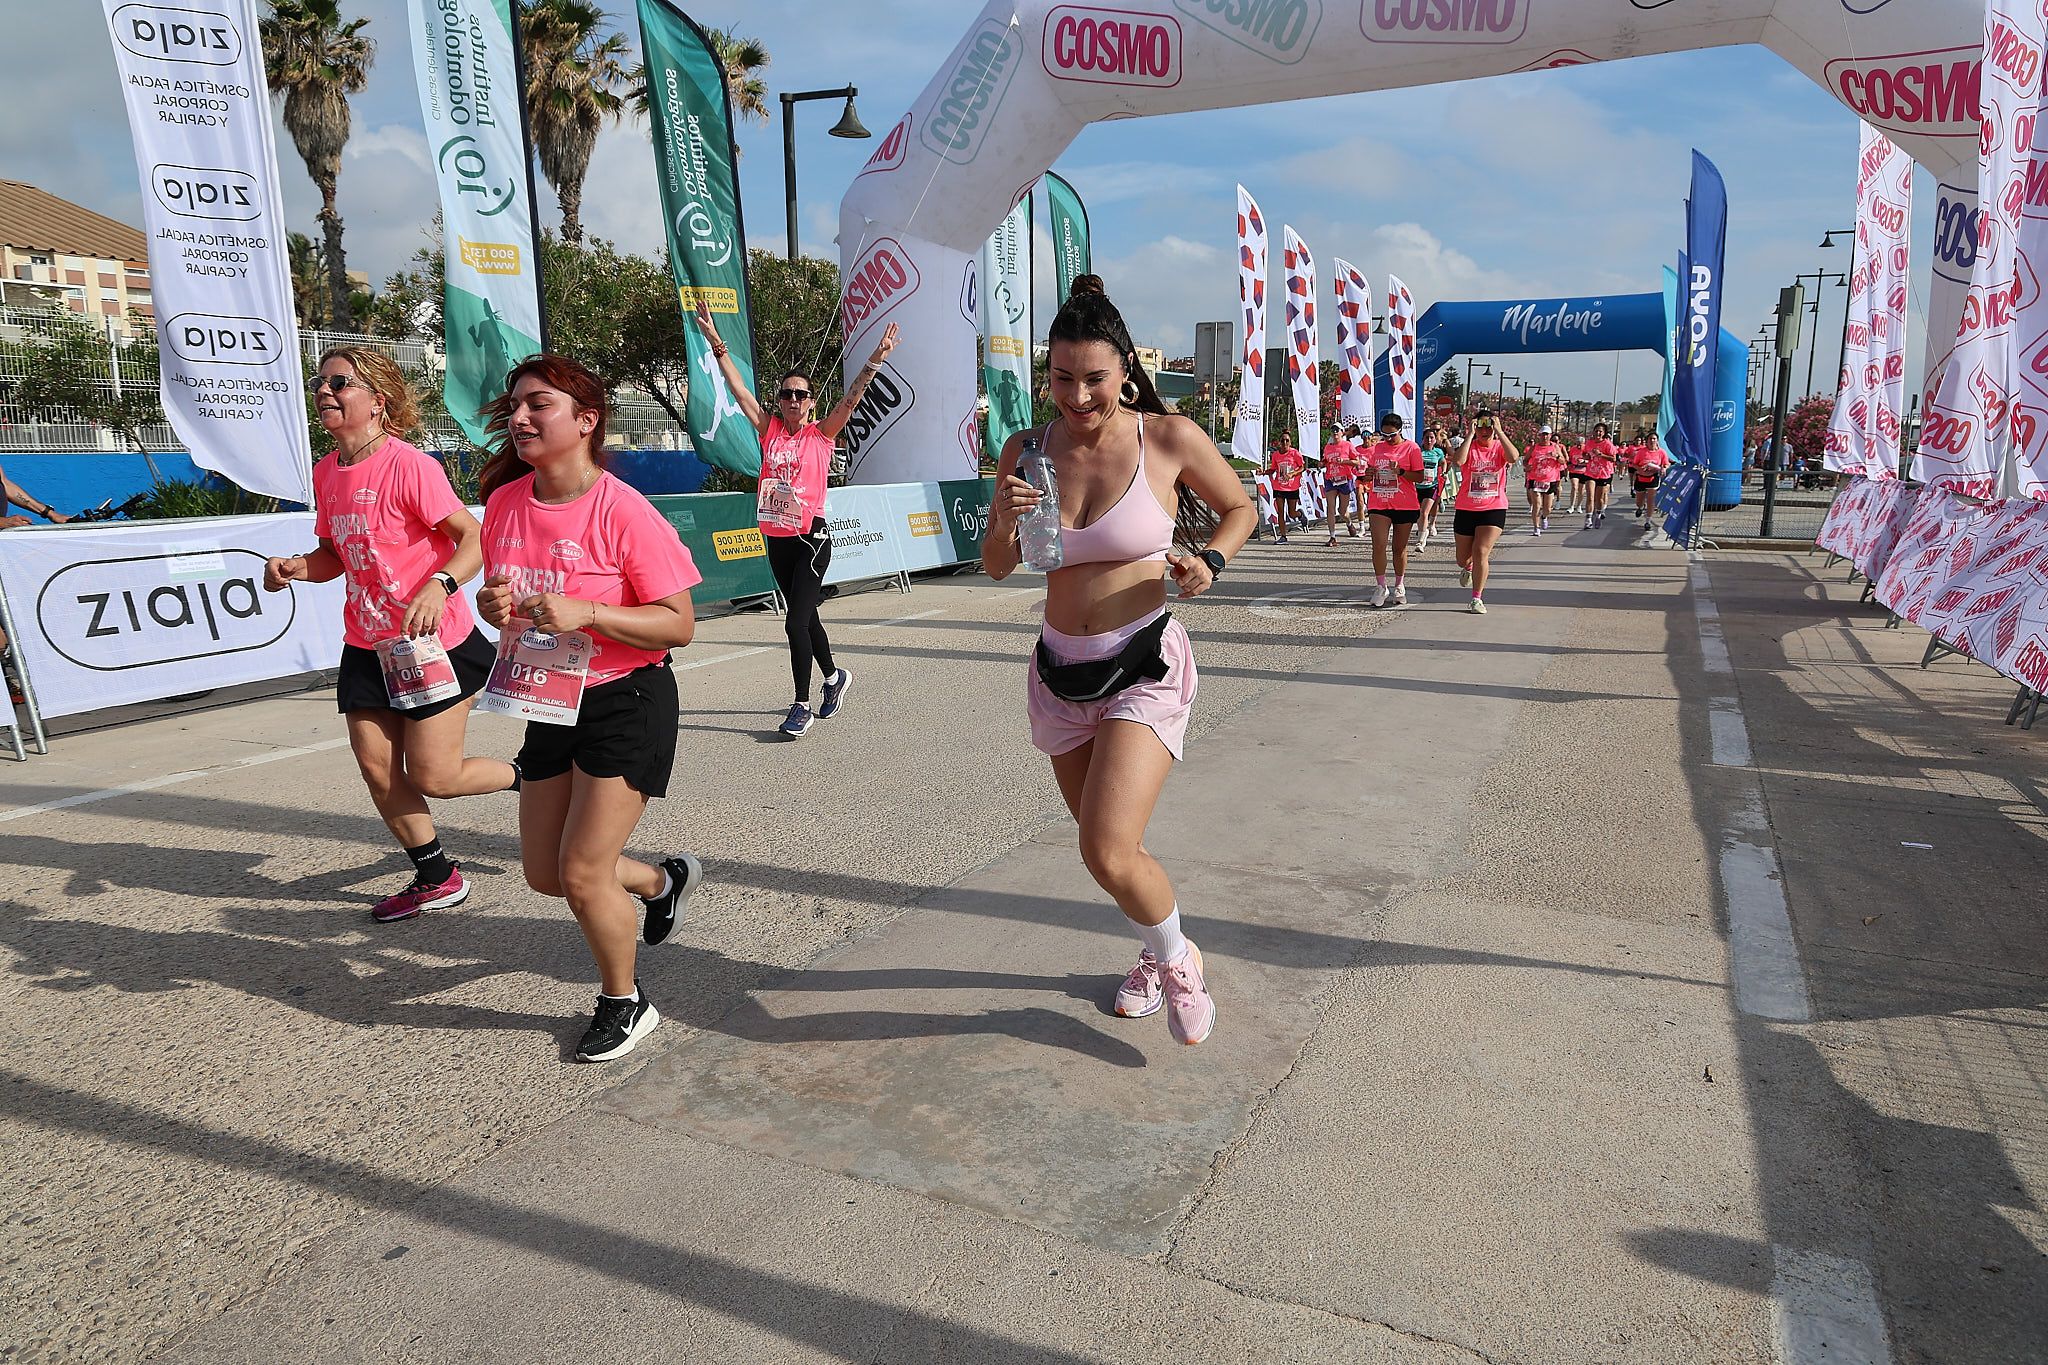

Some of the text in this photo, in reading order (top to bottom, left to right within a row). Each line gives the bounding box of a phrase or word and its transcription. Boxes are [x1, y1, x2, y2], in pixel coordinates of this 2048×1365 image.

[1054, 16, 1170, 77] COSMO
[930, 30, 1012, 150] COSMO
[1501, 302, 1602, 345] Marlene
[910, 517, 921, 526] 900
[1995, 503, 2043, 539] COSMO
[496, 538, 524, 549] OYSHO
[717, 532, 760, 546] 900 131 002
[719, 543, 763, 556] www.ioa.es
[1976, 529, 2031, 567] COSMO
[1994, 545, 2044, 577] COSMO
[76, 577, 263, 641] ziaja
[1965, 587, 2016, 617] COSMO
[400, 666, 424, 681] 016
[511, 663, 548, 685] 016
[516, 683, 531, 693] 259
[518, 693, 537, 701] MUJER
[541, 697, 567, 707] VALENCIA
[531, 708, 564, 719] Santander
